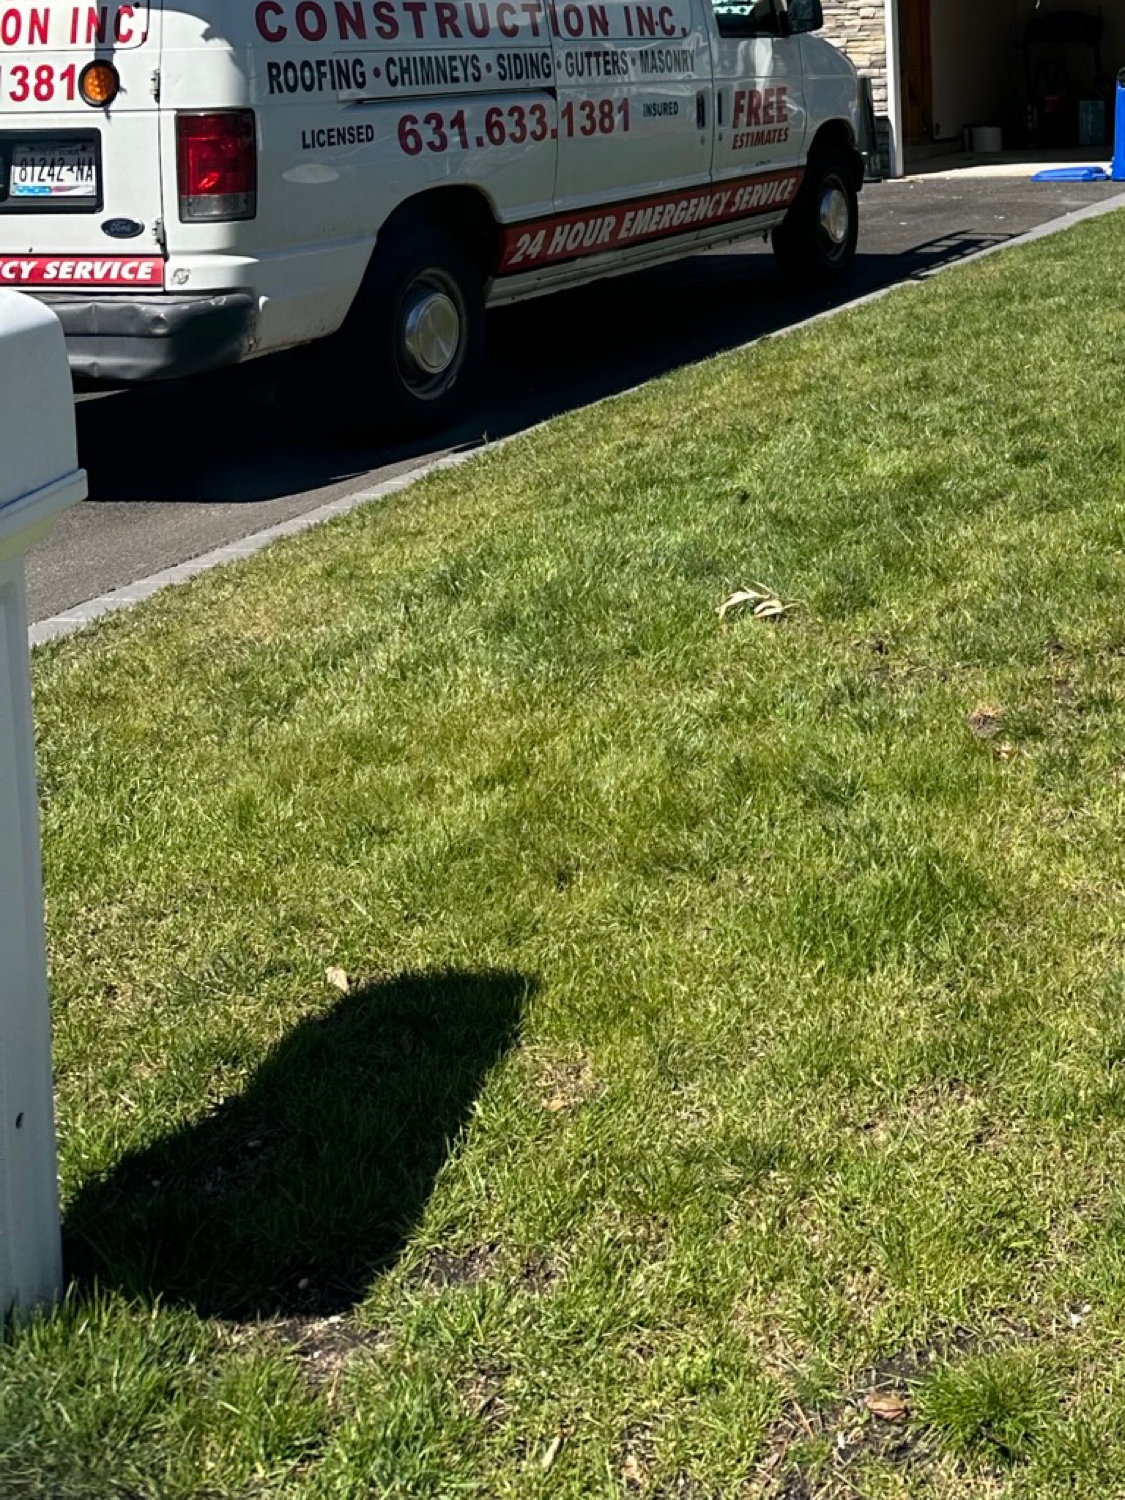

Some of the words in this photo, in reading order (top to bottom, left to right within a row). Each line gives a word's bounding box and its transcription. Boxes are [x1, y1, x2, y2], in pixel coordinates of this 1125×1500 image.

[70, 5, 148, 44] INC.
[255, 0, 610, 43] CONSTRUCTION
[625, 5, 688, 38] INC.
[0, 64, 76, 102] 381
[267, 58, 367, 95] ROOFING
[386, 54, 482, 87] CHIMNEYS
[497, 52, 552, 82] SIDING
[565, 50, 629, 79] GUTTERS
[639, 49, 696, 75] MASONRY
[302, 124, 375, 150] LICENSED
[398, 97, 631, 156] 631.633.1381
[643, 102, 679, 118] INSURED
[732, 86, 789, 129] FREE
[732, 127, 790, 150] ESTIMATES
[507, 229, 547, 265] 24
[547, 214, 616, 256] HOUR
[619, 190, 731, 240] EMERGENCY
[730, 179, 798, 213] SERVICE
[0, 260, 38, 279] CY
[43, 260, 155, 280] SERVICE
